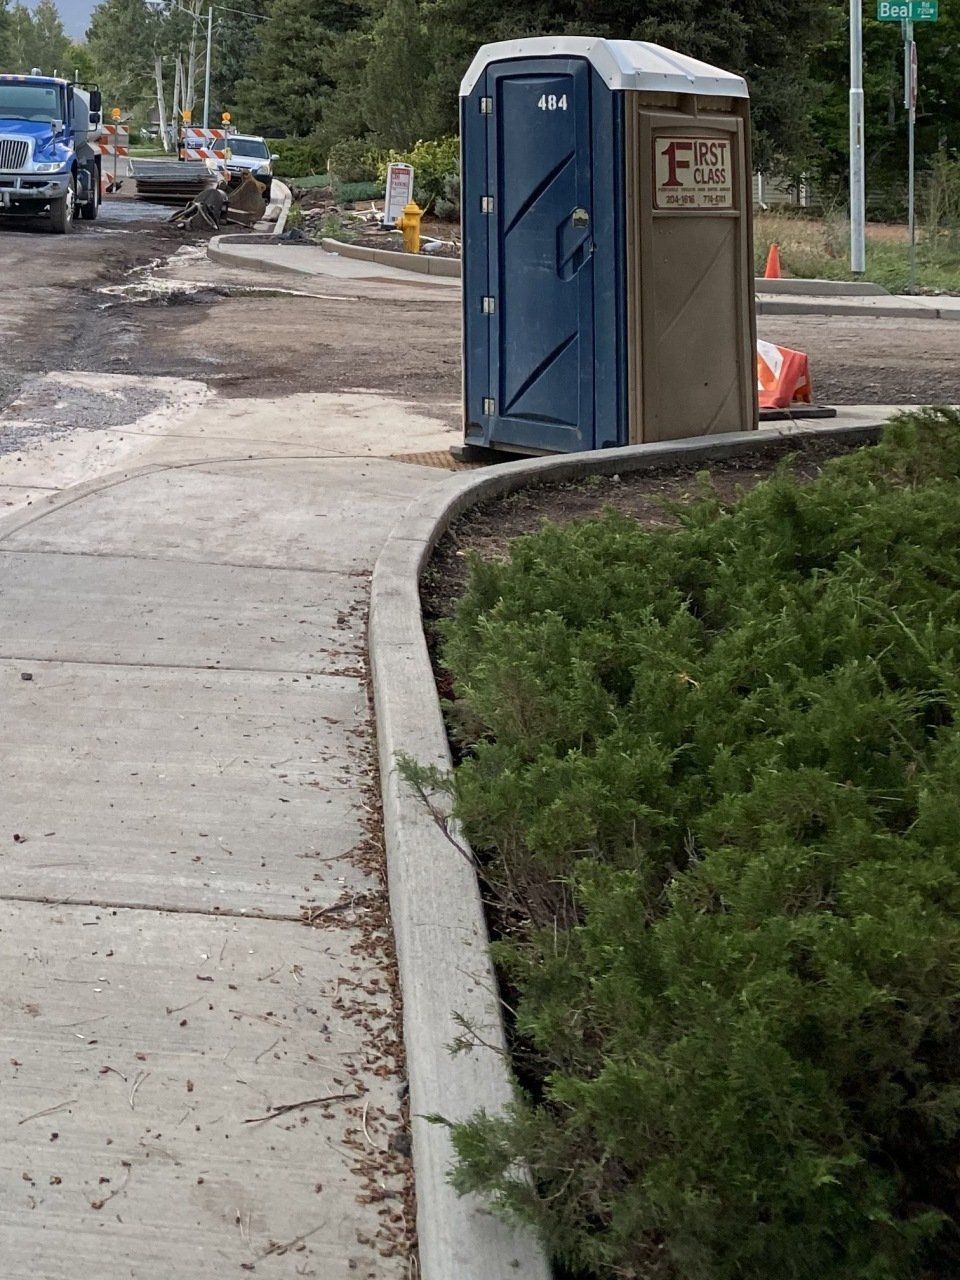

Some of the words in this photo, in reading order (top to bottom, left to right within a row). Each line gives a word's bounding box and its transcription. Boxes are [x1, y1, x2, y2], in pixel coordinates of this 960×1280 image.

[880, 2, 912, 17] Beal
[538, 94, 567, 110] 484
[693, 168, 726, 184] CLASS
